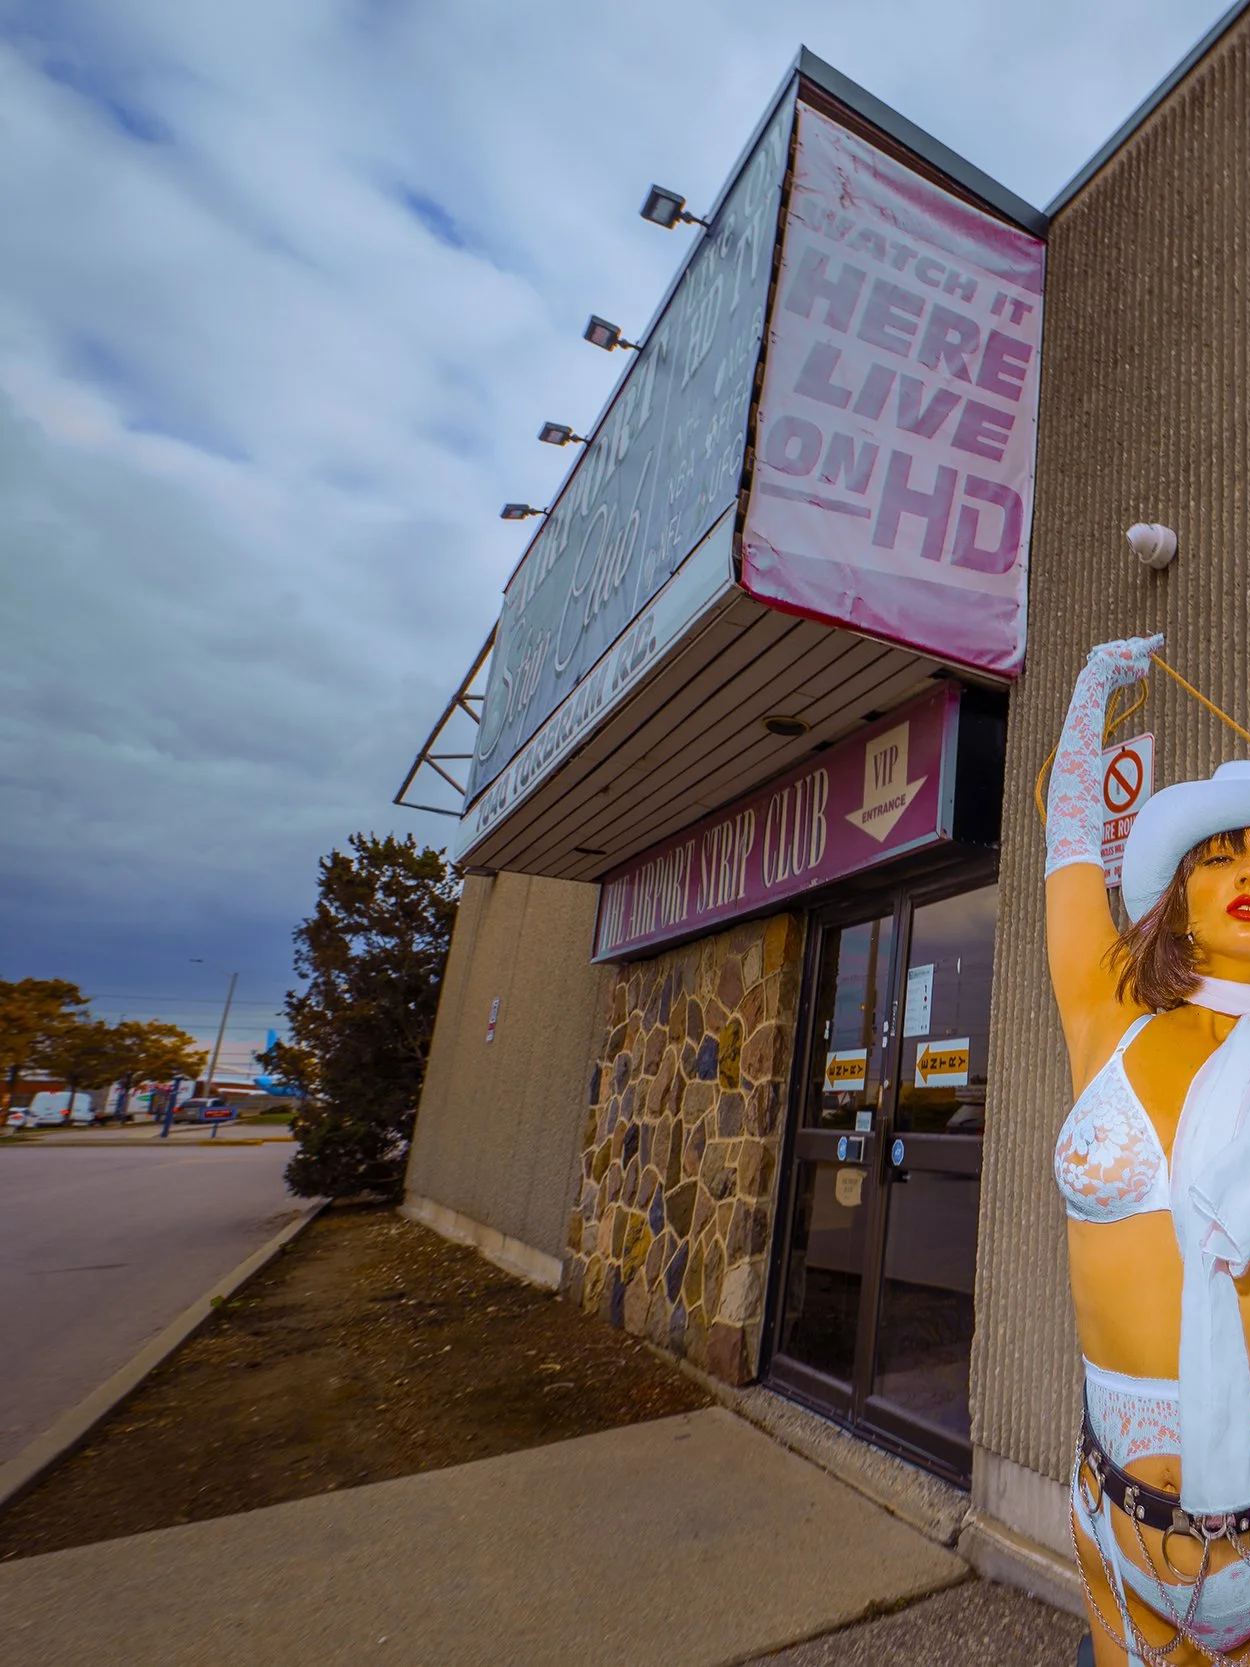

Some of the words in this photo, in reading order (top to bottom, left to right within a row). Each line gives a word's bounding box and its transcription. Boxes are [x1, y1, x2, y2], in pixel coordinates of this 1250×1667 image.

[681, 272, 723, 389] HD
[730, 184, 775, 315] TV
[785, 245, 1033, 403] HERE
[801, 196, 979, 304] WATCH
[989, 282, 1033, 327] IT
[794, 339, 1017, 463] LIVE
[504, 328, 670, 616] AIRPORT
[659, 510, 682, 562] NFL
[708, 430, 743, 503] UFC
[667, 449, 695, 505] NBA
[765, 414, 879, 494] ON
[872, 450, 1023, 575] HD
[478, 617, 552, 761] Strip
[555, 448, 653, 672] Club
[861, 794, 907, 824] ENTRANCE
[873, 744, 899, 791] VIP
[601, 874, 630, 950] THE
[625, 839, 696, 943] AIRPORT
[696, 808, 756, 915] STRIP
[761, 769, 829, 888] CLUB
[829, 1063, 865, 1077] ENTRY
[920, 1056, 967, 1070] ENTRY
